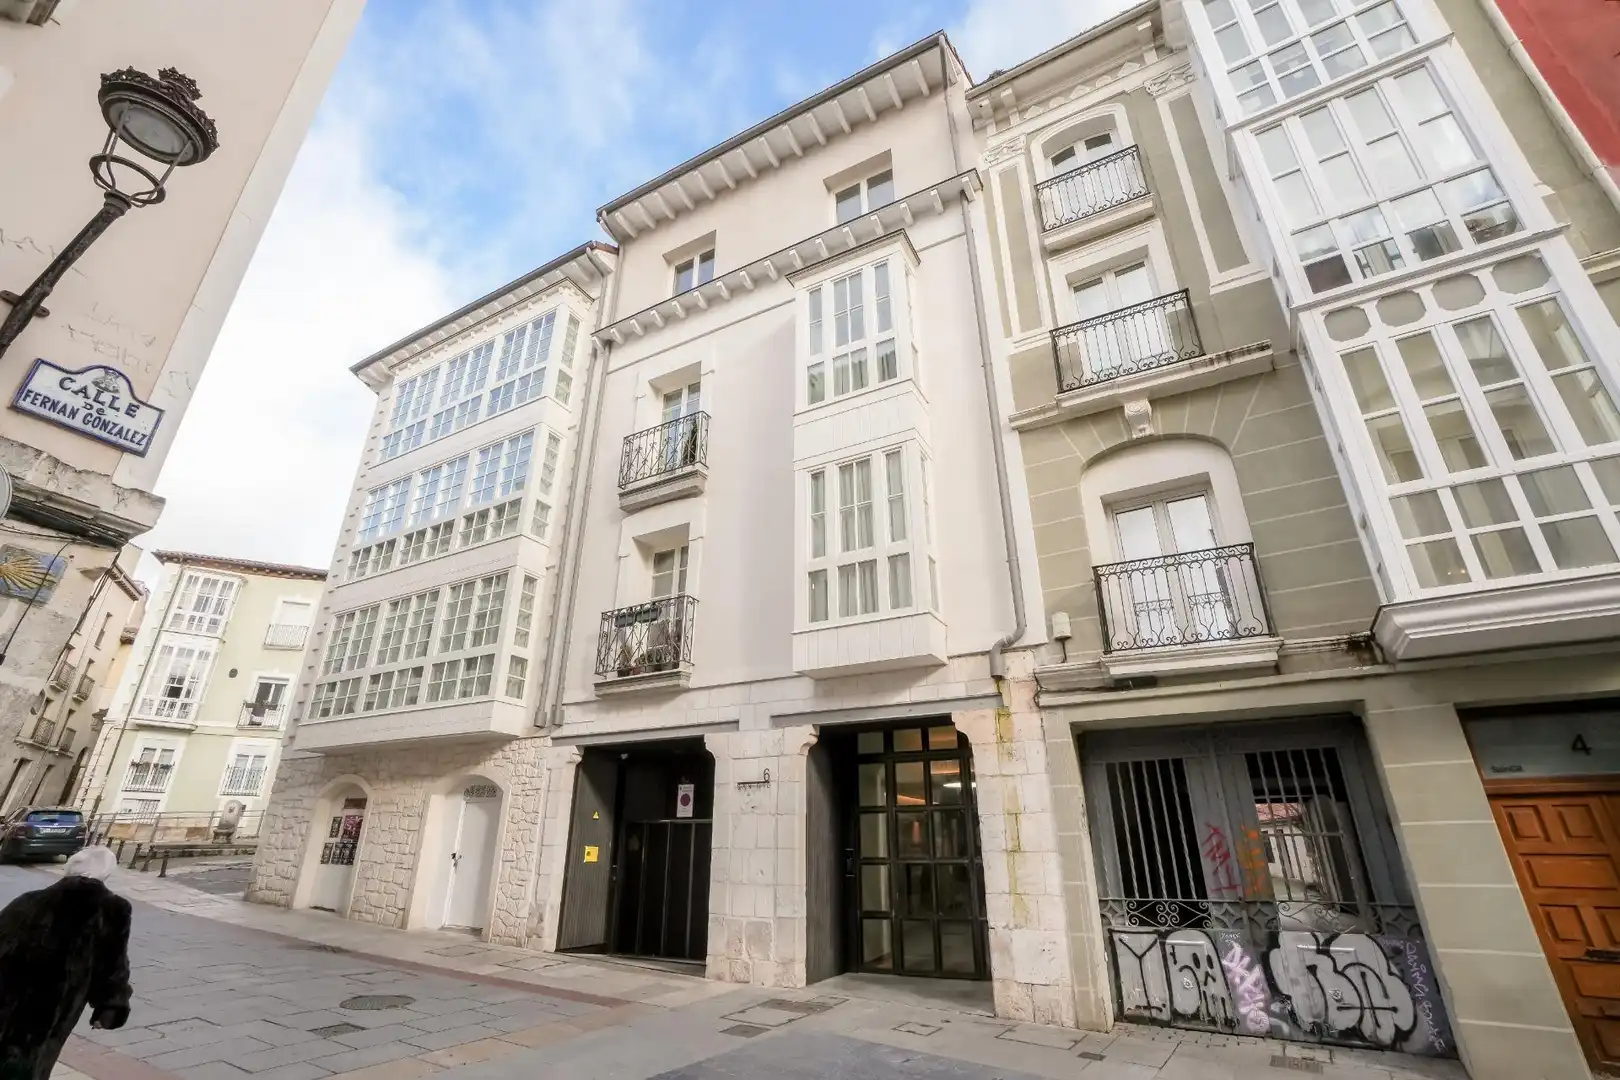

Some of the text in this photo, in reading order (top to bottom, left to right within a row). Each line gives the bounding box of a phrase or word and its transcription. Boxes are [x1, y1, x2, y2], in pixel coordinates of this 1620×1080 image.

[59, 376, 141, 418] CALLE
[22, 389, 149, 446] FERNAN GONZALEZ
[1571, 733, 1592, 756] 4
[763, 767, 770, 781] 6
